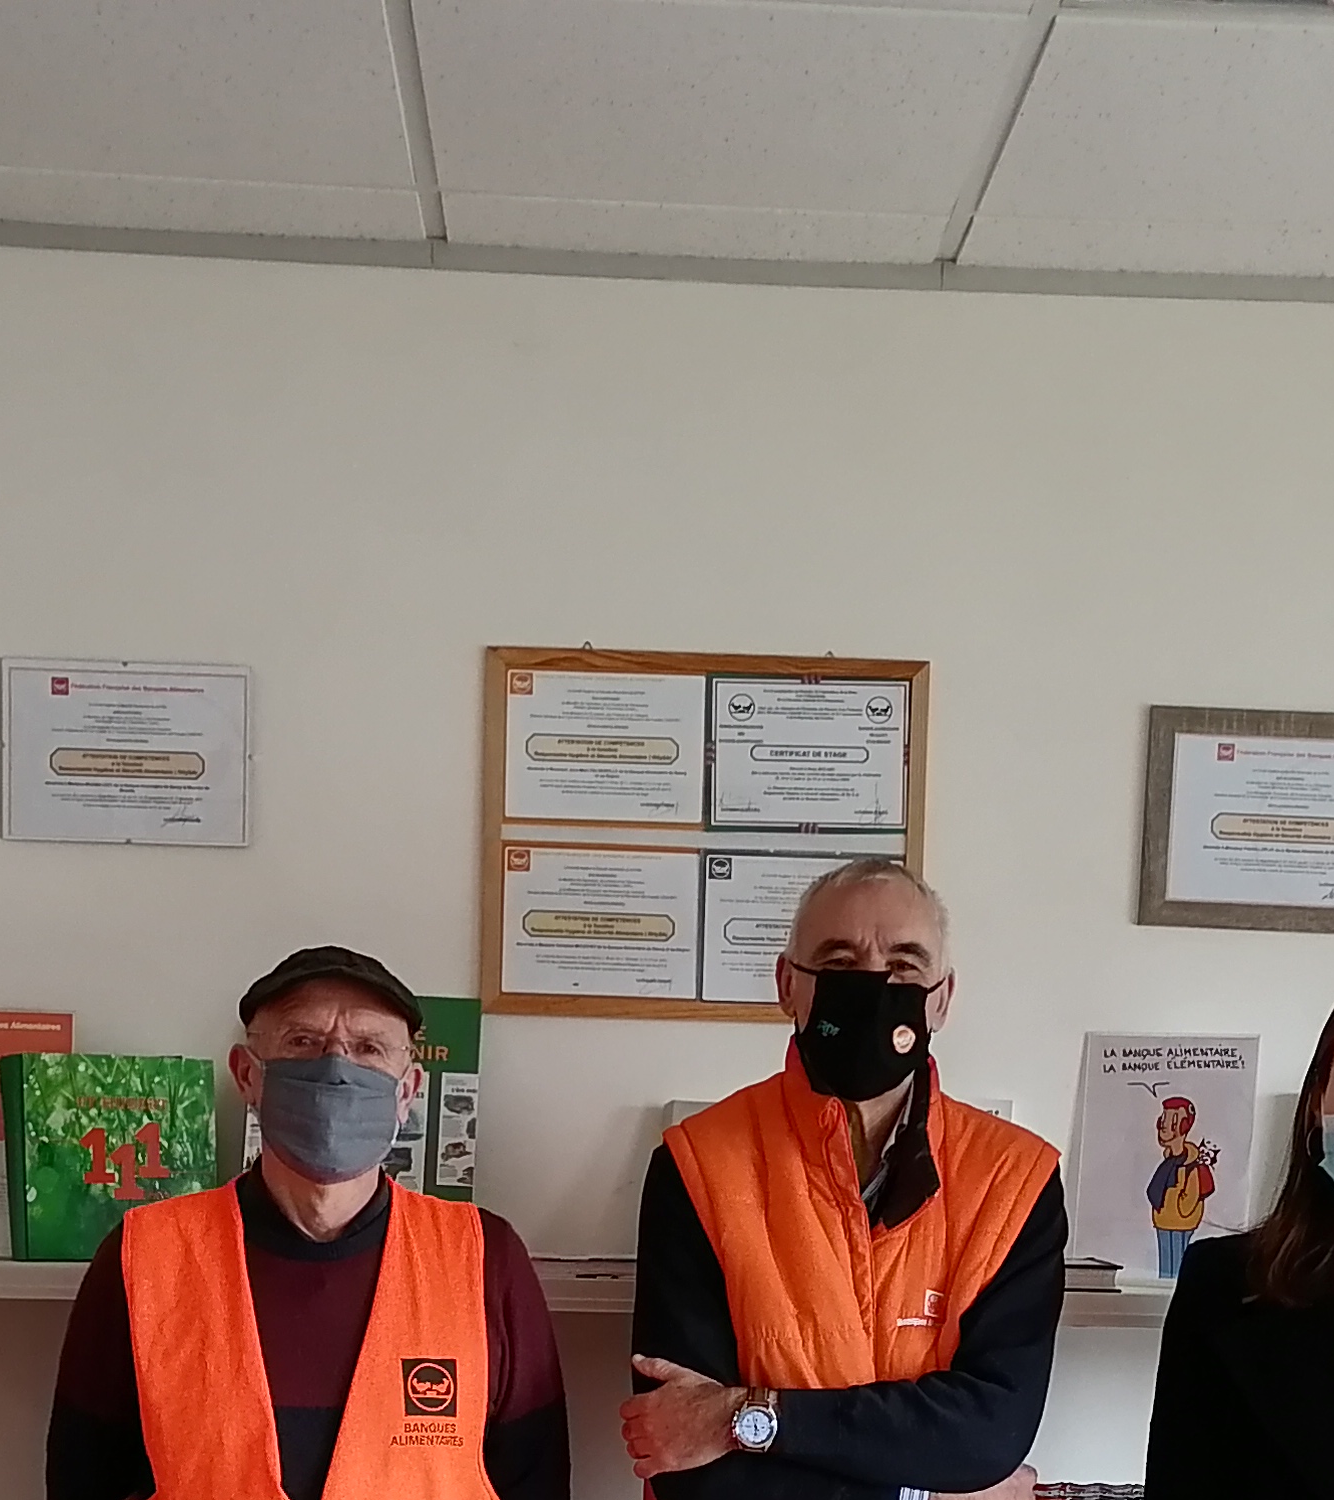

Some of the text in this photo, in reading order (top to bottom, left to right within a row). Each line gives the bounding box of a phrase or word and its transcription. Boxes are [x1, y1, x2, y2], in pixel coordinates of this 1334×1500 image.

[1103, 1048, 1117, 1058] LA
[1122, 1047, 1163, 1060] BANQUE
[1103, 1064, 1117, 1073] LA
[1121, 1062, 1160, 1074] BANQUE
[404, 1422, 457, 1434] BANQUES
